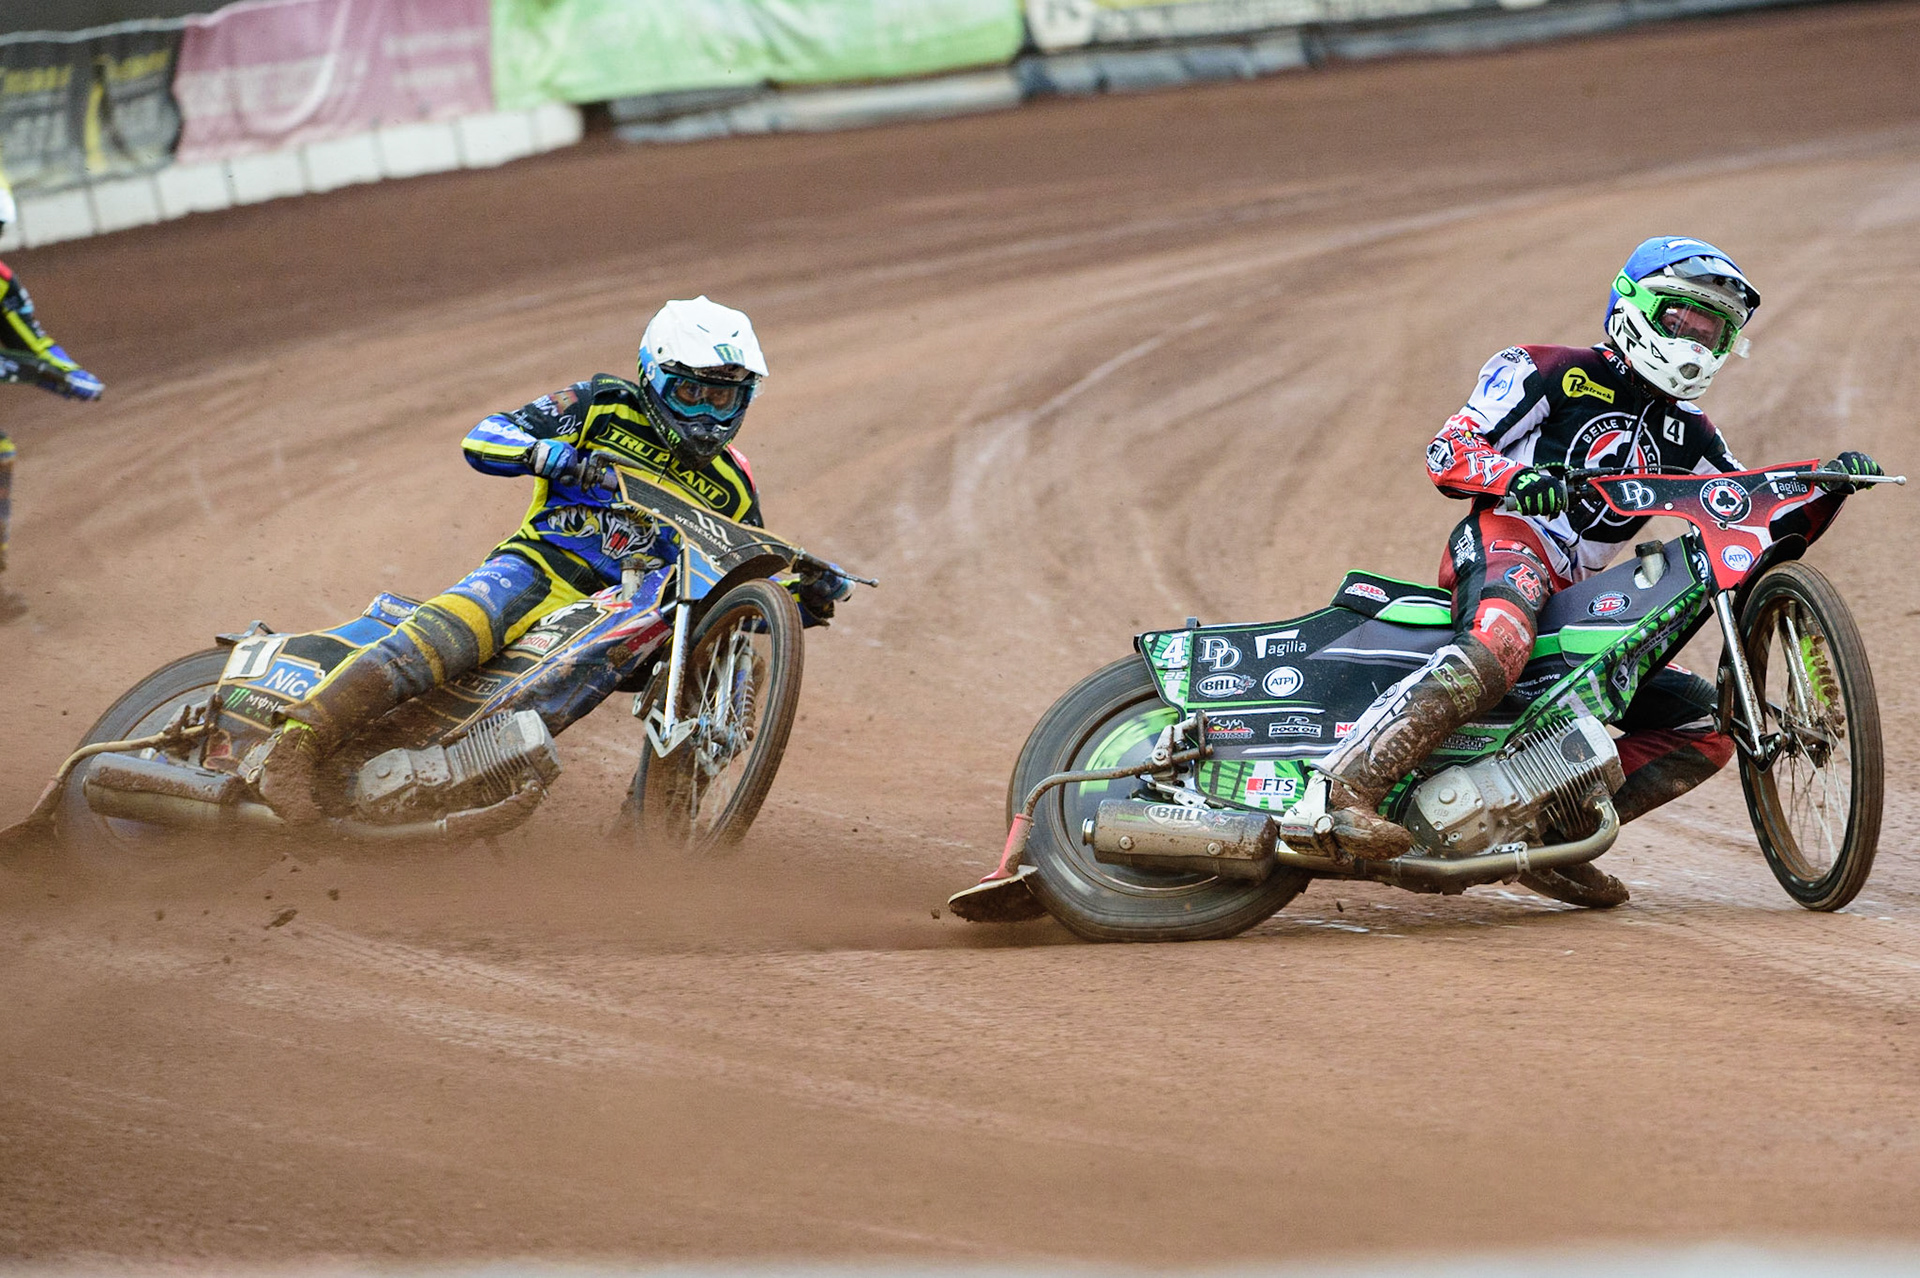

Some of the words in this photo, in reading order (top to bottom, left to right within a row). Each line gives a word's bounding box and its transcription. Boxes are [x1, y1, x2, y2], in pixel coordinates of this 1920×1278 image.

[1609, 355, 1629, 375] FTS
[1582, 419, 1619, 444] BELLE
[1667, 420, 1680, 442] 4
[608, 428, 654, 457] TRU
[653, 452, 724, 501] PLANT
[1779, 481, 1808, 495] agilia
[1728, 553, 1748, 562] ATPI
[1595, 600, 1623, 610] STS
[1161, 637, 1185, 664] 4
[1268, 641, 1307, 657] agilia
[240, 640, 268, 675] 1
[1163, 671, 1187, 681] 26
[1270, 677, 1294, 686] ATPI
[1301, 726, 1319, 734] OIL
[1262, 778, 1294, 792] FTS
